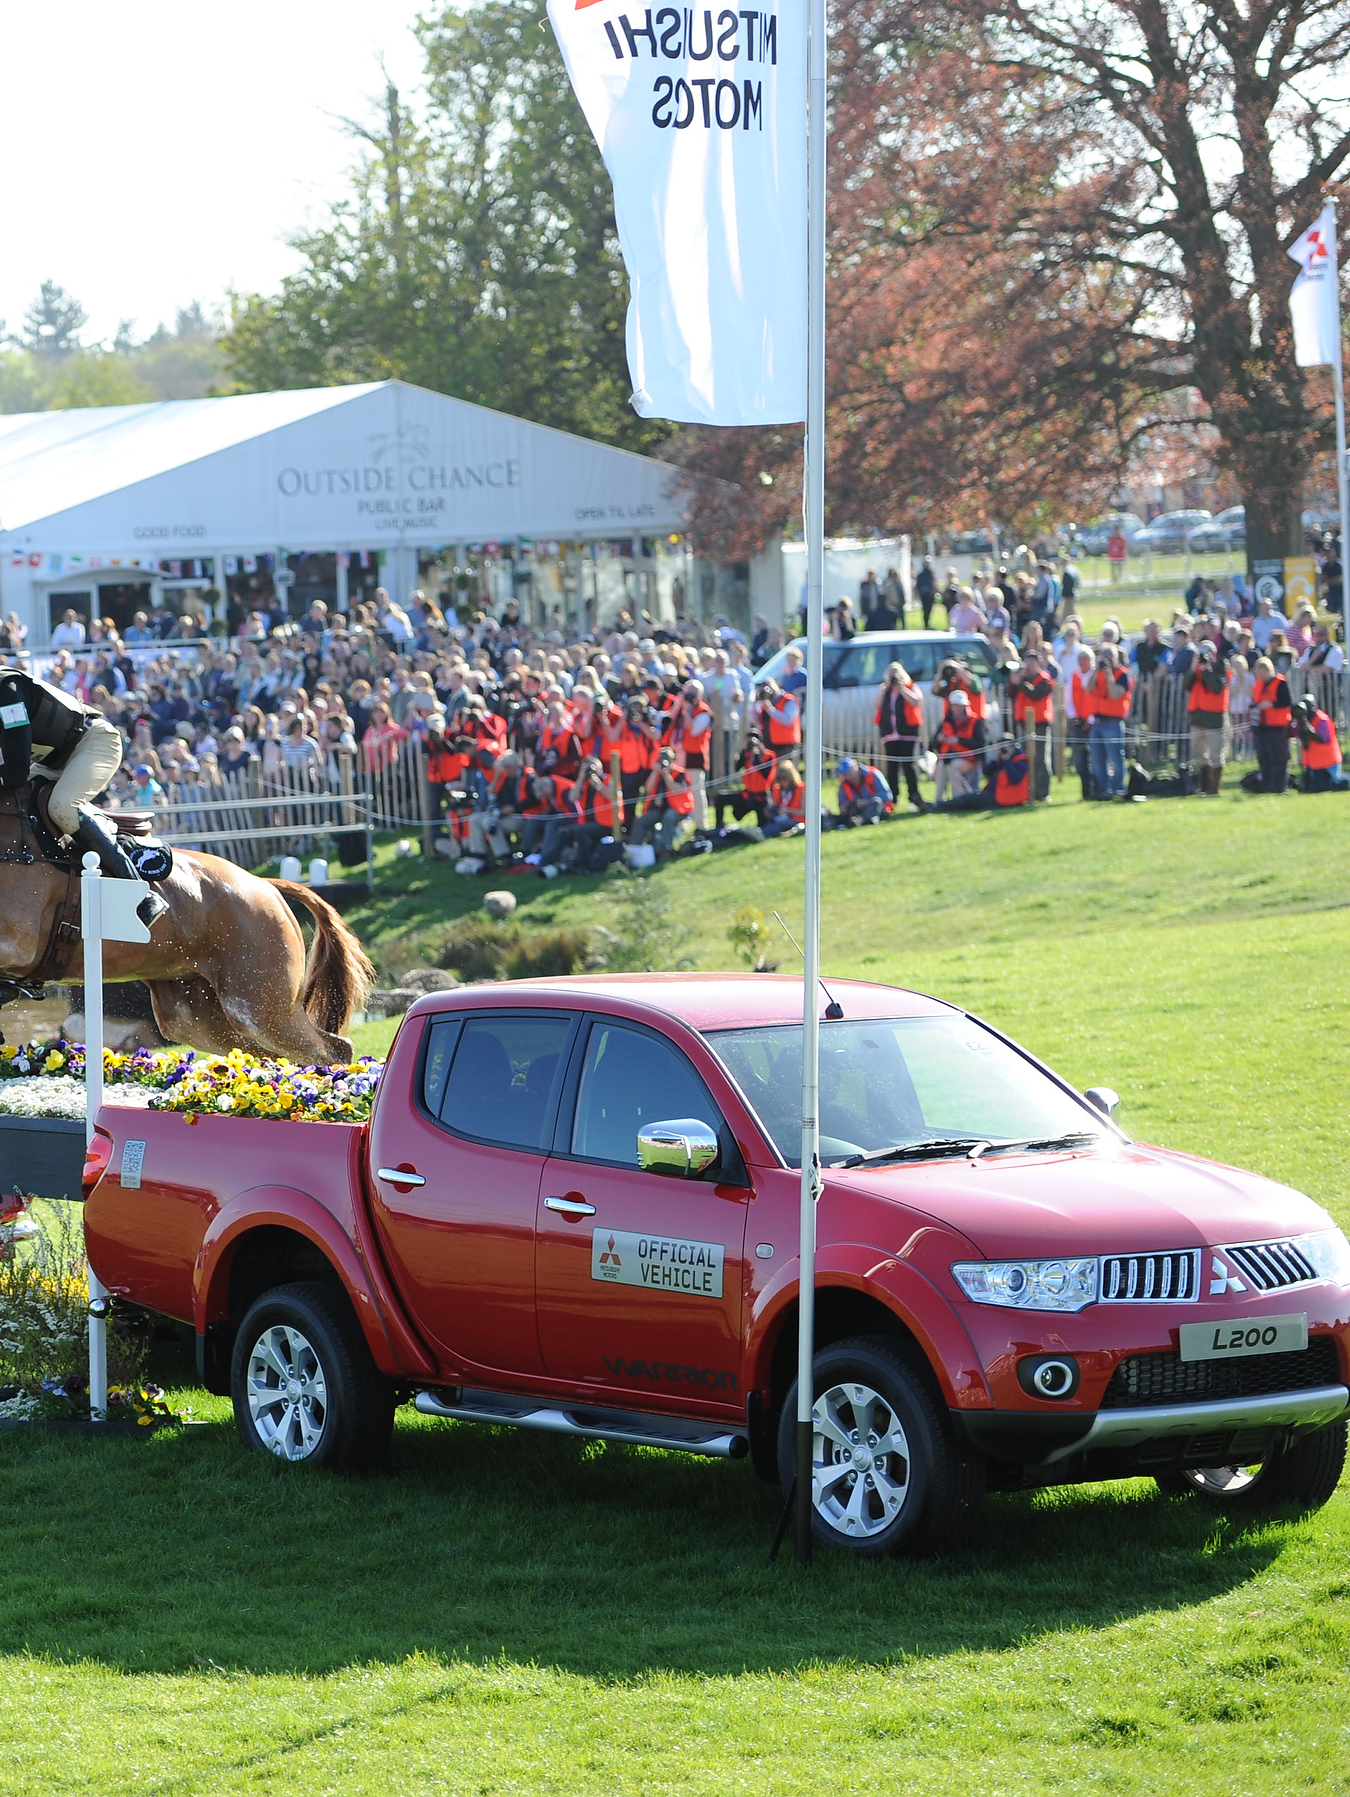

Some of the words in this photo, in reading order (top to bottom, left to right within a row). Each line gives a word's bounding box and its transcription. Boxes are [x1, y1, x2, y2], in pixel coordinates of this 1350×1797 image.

[277, 466, 397, 497] OUTSIDE
[407, 459, 520, 491] CHANCE
[357, 498, 412, 515] PUBLIC
[417, 496, 446, 512] BAR
[133, 525, 170, 540] GOOD
[172, 524, 207, 539] FOOD
[637, 1238, 717, 1269] OFFICIAL
[640, 1262, 713, 1292] VEHICLE
[1212, 1326, 1278, 1350] L200
[601, 1355, 740, 1394] WARRIOR
